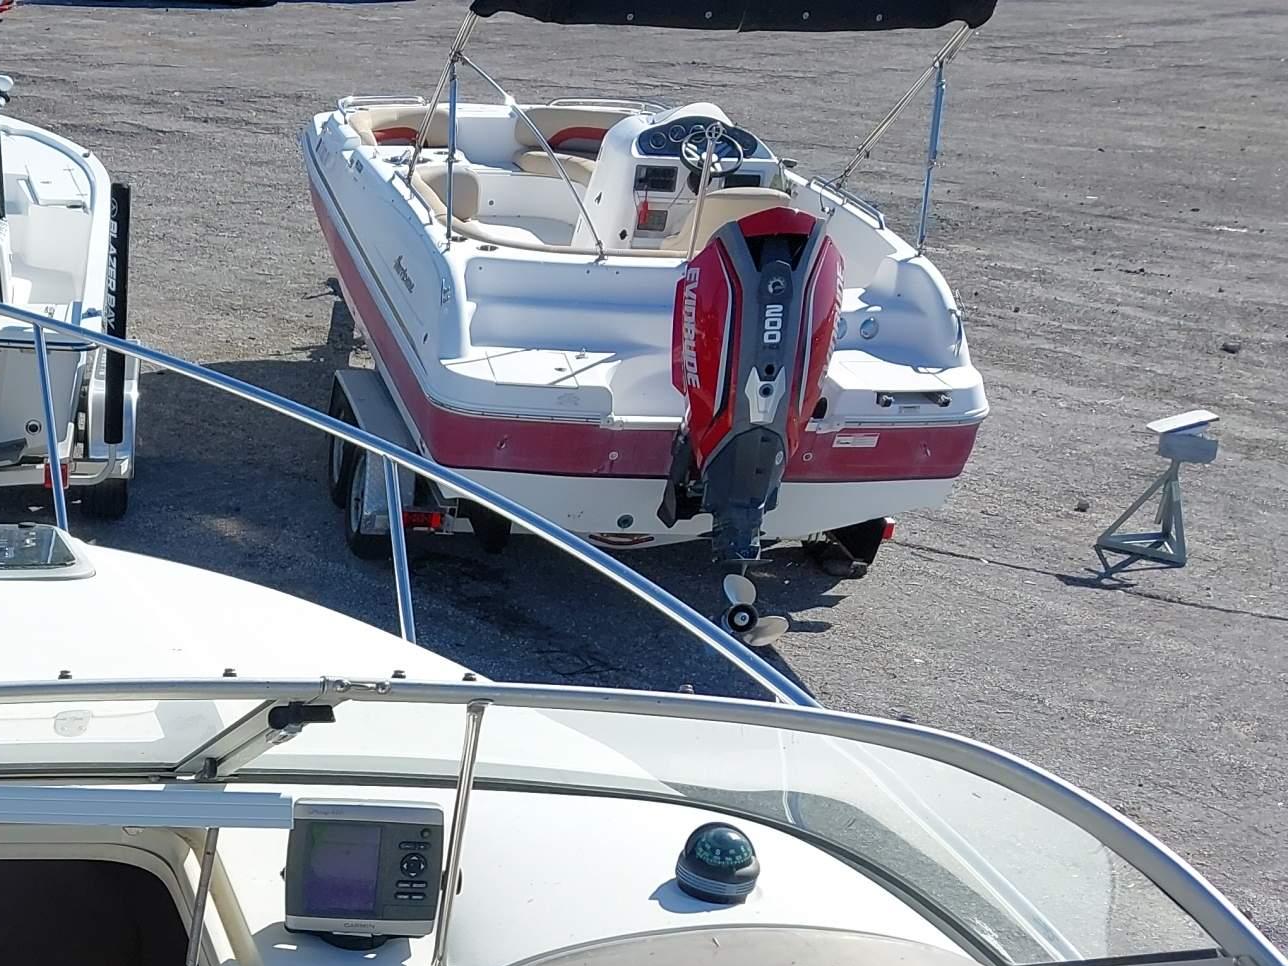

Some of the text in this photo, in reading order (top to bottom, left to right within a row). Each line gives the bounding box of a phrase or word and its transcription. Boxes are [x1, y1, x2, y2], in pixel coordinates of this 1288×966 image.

[106, 219, 119, 331] BLAZER BAY
[684, 266, 701, 390] EVINRUDE
[763, 304, 784, 344] 200
